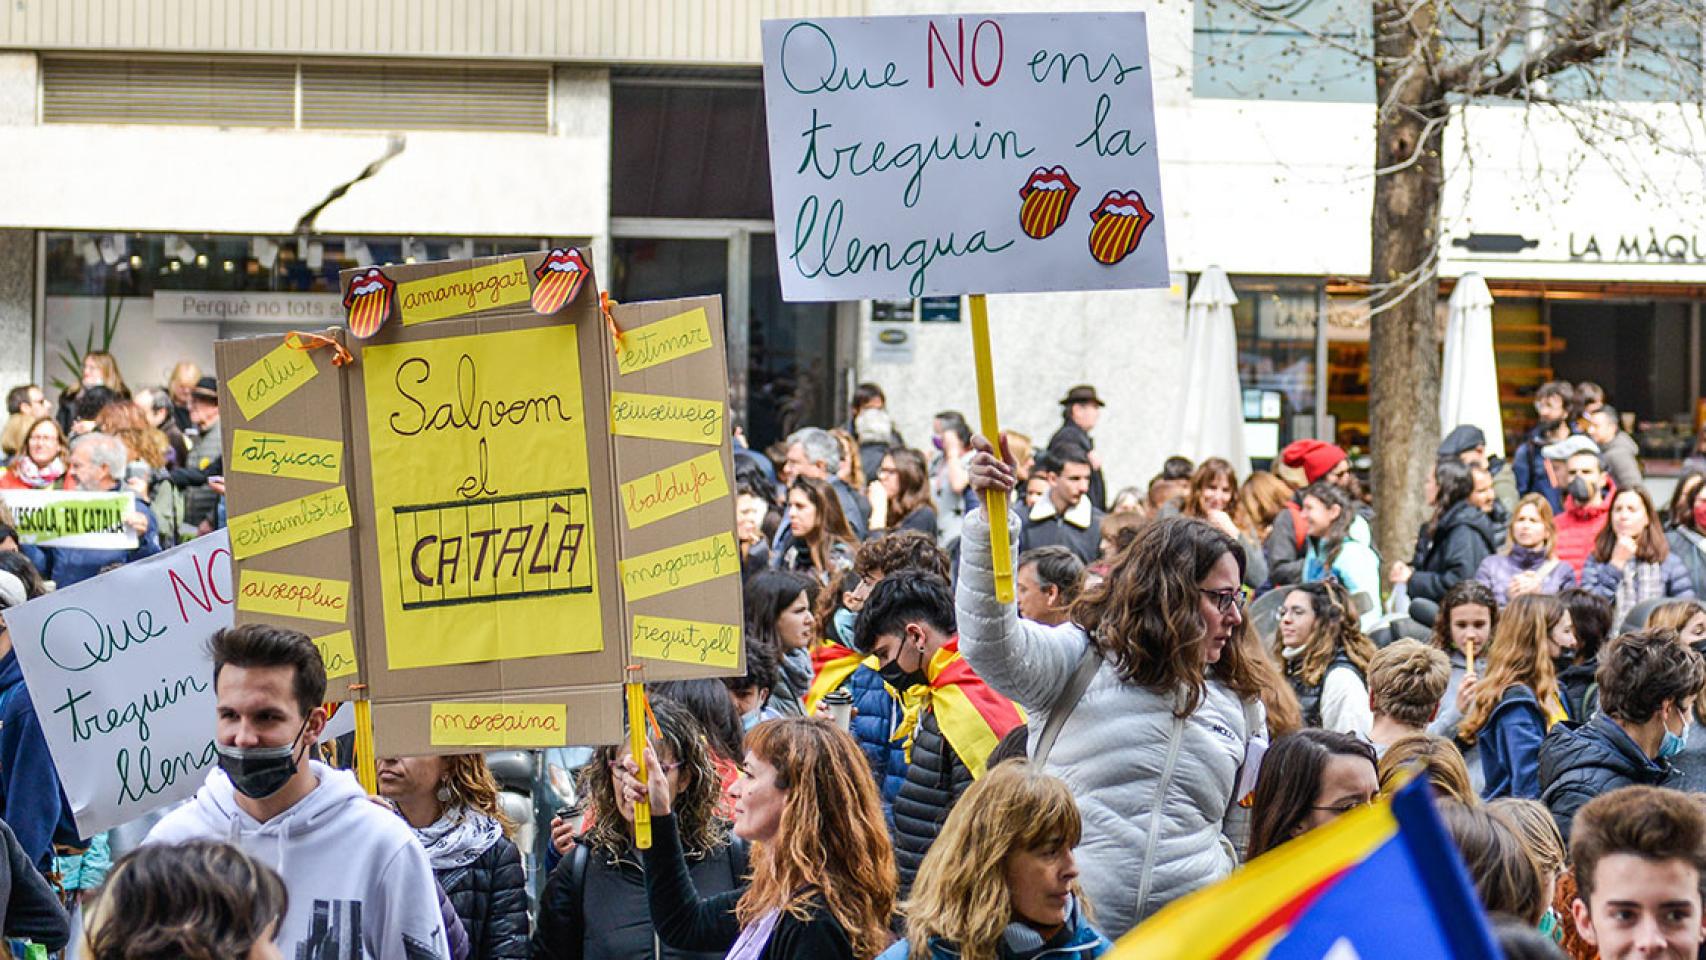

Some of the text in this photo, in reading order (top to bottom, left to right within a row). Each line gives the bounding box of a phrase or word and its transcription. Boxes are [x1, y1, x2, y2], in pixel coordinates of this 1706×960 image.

[780, 17, 1143, 94] Que NO ens
[797, 93, 1147, 208] treguin la
[789, 194, 1015, 297] llengua
[1568, 231, 1602, 258] LA
[182, 295, 251, 320] Perquè
[256, 302, 281, 316] no
[287, 299, 324, 316] tots
[402, 270, 528, 309] amanyagar
[621, 328, 709, 368] estimar
[246, 358, 305, 402] caliu
[389, 354, 573, 436] Salvem
[241, 436, 337, 473] atzucac
[456, 436, 499, 499] el
[628, 461, 716, 513] baldufa
[64, 507, 79, 533] EN
[82, 500, 125, 534] CATALÀ
[410, 502, 586, 587] CATALÀ
[625, 536, 736, 587] magarrufa
[242, 581, 345, 613] aixopluc
[40, 606, 168, 672] Que
[634, 622, 737, 662] reguitzell
[54, 674, 208, 743] treguin
[433, 709, 561, 732] moxaina
